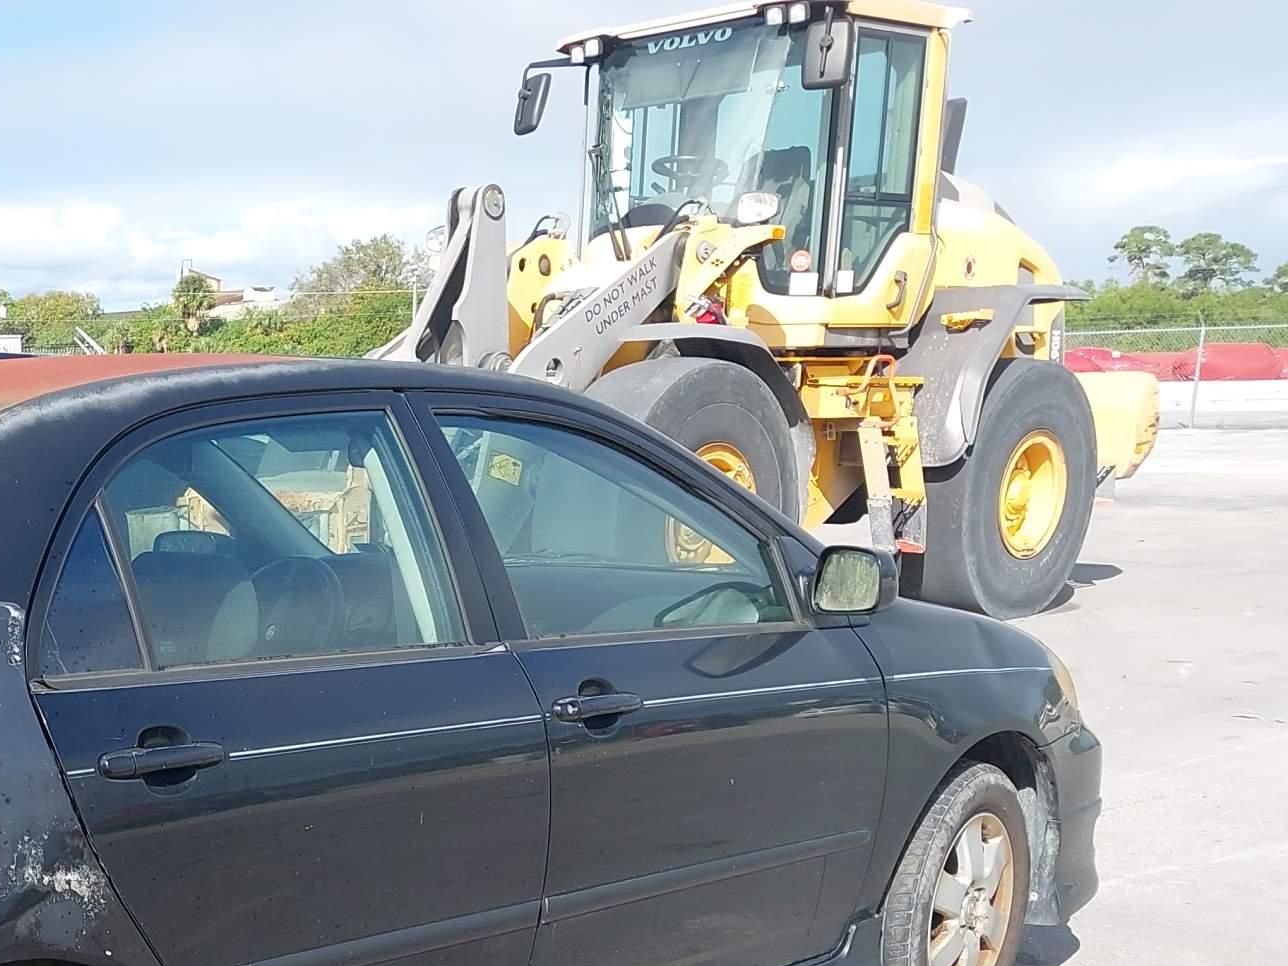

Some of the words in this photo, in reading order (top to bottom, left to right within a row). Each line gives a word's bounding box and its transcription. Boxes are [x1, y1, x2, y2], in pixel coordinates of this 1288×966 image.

[647, 27, 732, 55] VOLVO
[585, 303, 601, 322] DO
[603, 282, 625, 309] NOT
[627, 256, 657, 287] WALK
[596, 301, 631, 335] UNDER
[632, 277, 657, 306] MAST
